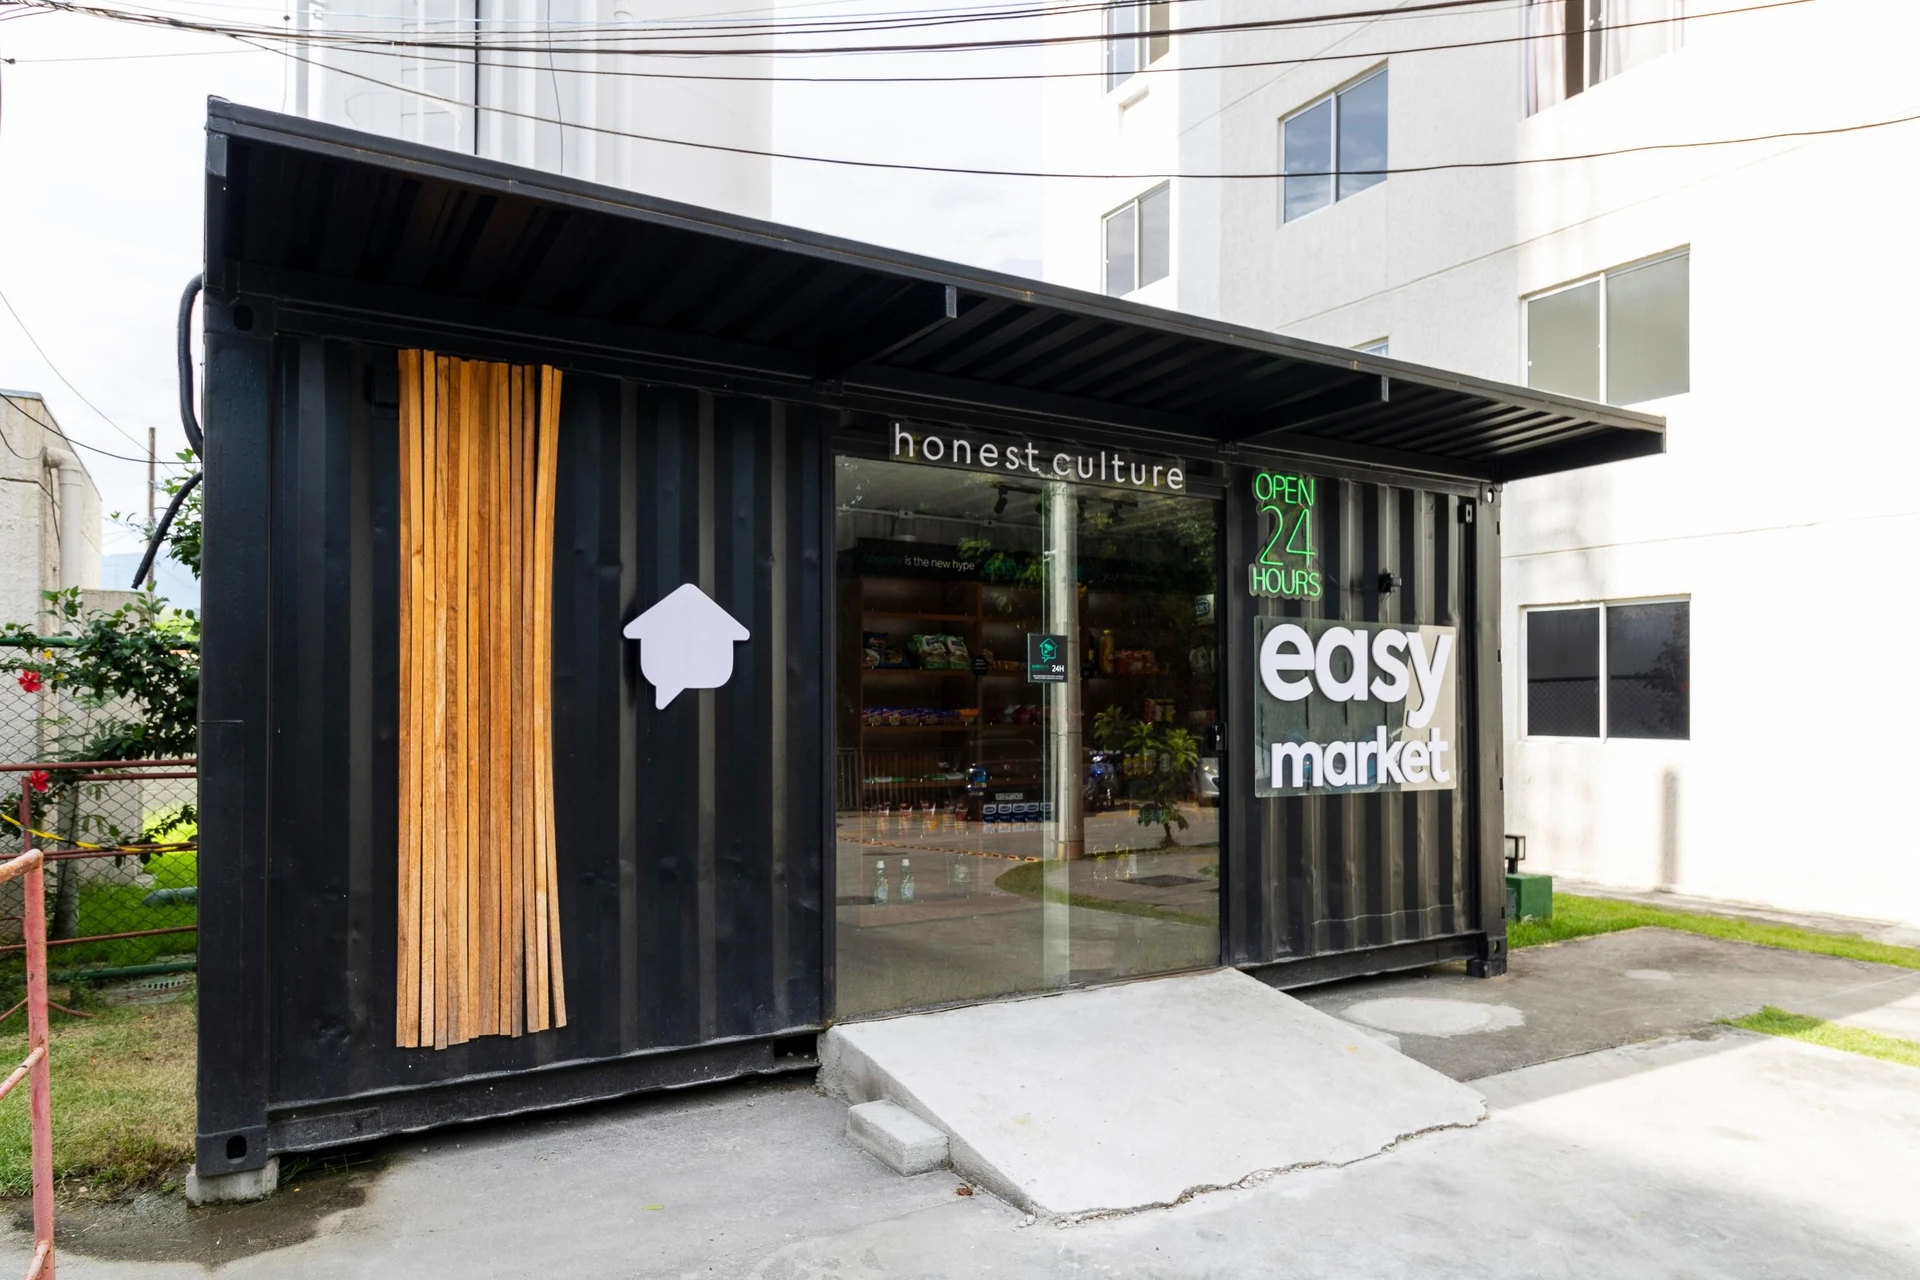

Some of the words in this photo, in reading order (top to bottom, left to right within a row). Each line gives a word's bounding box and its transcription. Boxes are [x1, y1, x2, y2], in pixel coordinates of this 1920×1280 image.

[895, 423, 1039, 473] honest
[1052, 451, 1184, 490] culture
[1254, 473, 1315, 505] OPEN
[904, 555, 912, 566] is
[913, 556, 930, 567] the
[931, 559, 951, 568] new
[952, 559, 975, 572] hype
[1259, 505, 1316, 567] 24
[1252, 567, 1322, 597] HOURS
[1259, 623, 1453, 729] easy
[1271, 725, 1451, 788] market
